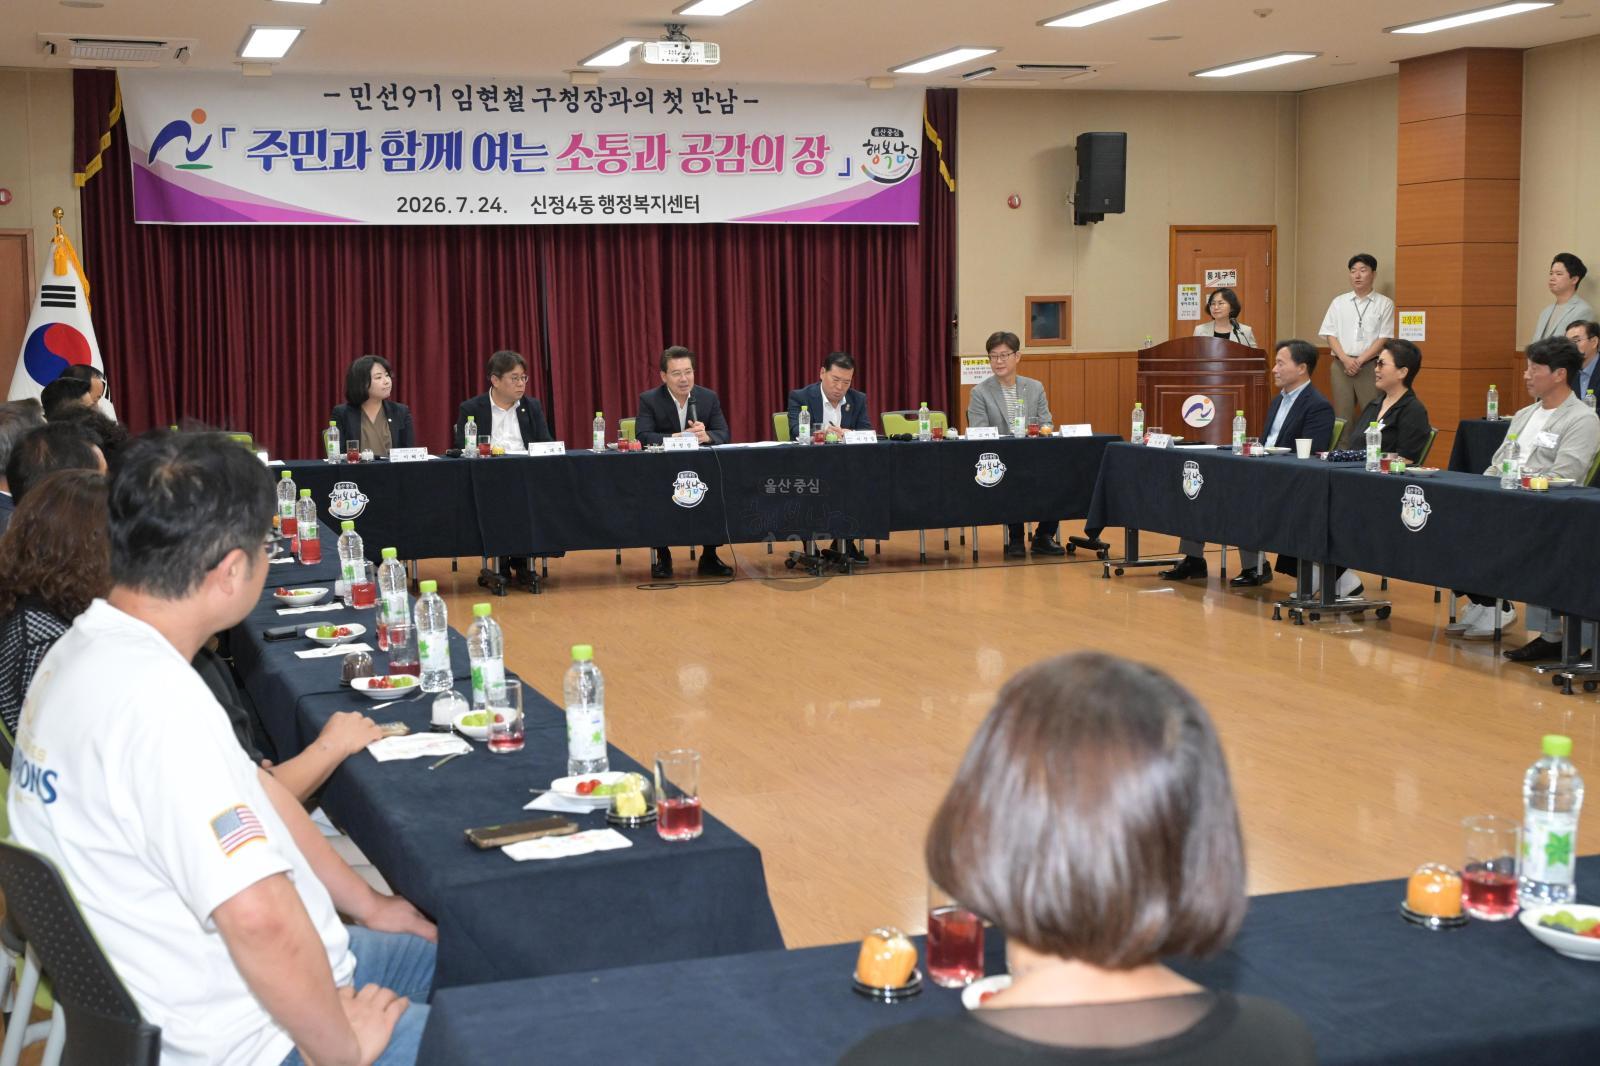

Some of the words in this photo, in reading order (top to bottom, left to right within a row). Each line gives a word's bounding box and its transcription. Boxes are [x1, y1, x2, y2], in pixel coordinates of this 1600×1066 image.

[348, 82, 442, 112] 민선9기
[451, 83, 525, 113] 임현철
[531, 84, 654, 114] 구청장과의
[662, 86, 684, 115] 첫
[380, 130, 463, 172] 함께
[472, 131, 549, 173] 여는
[556, 133, 671, 174] 소통과
[678, 134, 785, 174] 공감의
[862, 139, 919, 170] 행복남구
[397, 196, 507, 214] 2026.7.24.
[530, 195, 595, 215] 신정4동
[598, 194, 700, 215] 행정복지센터
[1207, 271, 1236, 280] 통제구역
[15, 748, 58, 804] ONS
